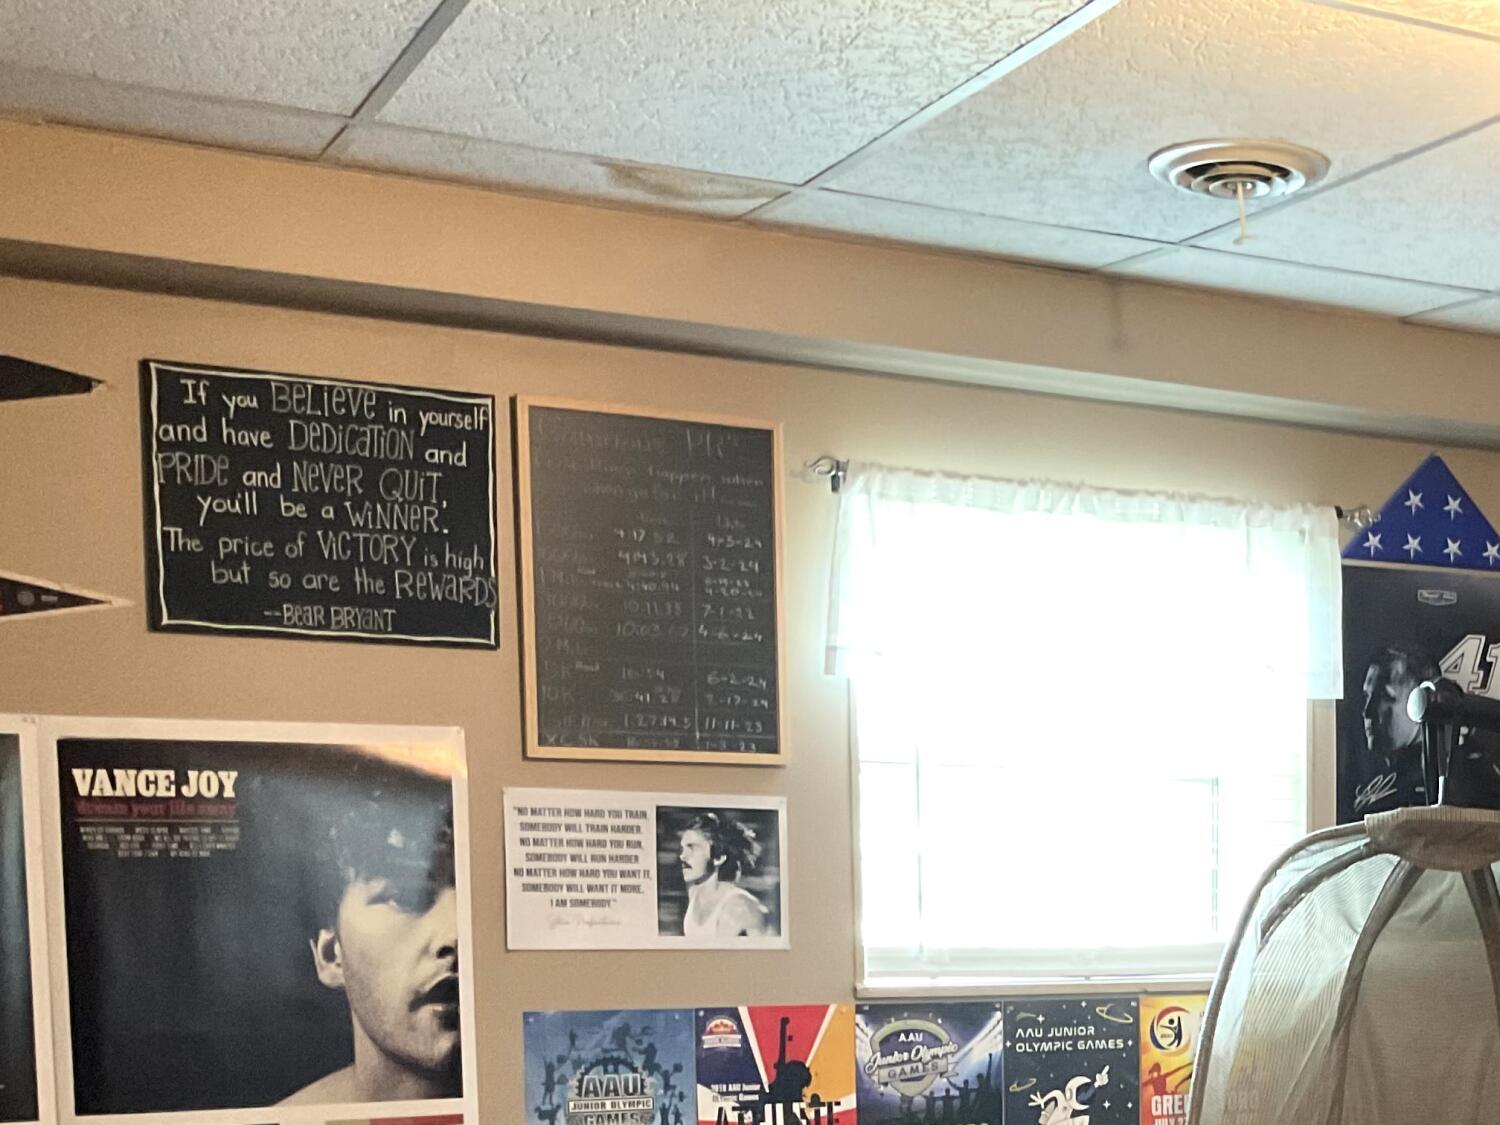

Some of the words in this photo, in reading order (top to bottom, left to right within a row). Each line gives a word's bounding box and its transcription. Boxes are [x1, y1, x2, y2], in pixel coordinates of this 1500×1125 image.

[180, 379, 209, 405] If
[222, 393, 258, 419] you
[389, 401, 406, 424] in
[419, 406, 489, 437] yourself
[159, 417, 207, 443] and
[222, 418, 274, 447] have
[425, 441, 467, 467] and
[243, 463, 281, 489] and
[197, 491, 257, 526] you'll
[281, 499, 307, 518] be
[322, 505, 334, 519] a
[163, 527, 204, 552] The
[219, 536, 274, 559] price
[285, 531, 306, 558] of
[424, 548, 438, 567] is
[445, 543, 484, 580] high
[212, 562, 251, 585] but
[269, 573, 291, 590] so
[302, 577, 340, 591] are
[355, 567, 385, 595] the
[72, 769, 176, 797] VANCE
[181, 771, 238, 798] JOY
[530, 807, 561, 817] MATTER
[564, 808, 582, 817] HOW
[584, 808, 605, 818] HARD
[607, 809, 622, 818] YOU
[520, 822, 562, 832] SOMEBODY
[564, 823, 583, 832] WILL
[585, 823, 608, 833] TRAIN
[520, 837, 529, 846] NO
[530, 838, 563, 848] MATTER
[566, 839, 583, 847] HOW
[585, 839, 607, 848] HARD
[610, 839, 624, 848] YOU
[525, 852, 567, 863] SOMEBODY
[570, 853, 588, 863] WILL
[590, 855, 606, 864] RUN
[514, 868, 524, 877] NO
[526, 868, 557, 878] MATTER
[559, 869, 577, 878] HOW
[579, 869, 601, 878] HARD
[603, 869, 618, 878] YOU
[620, 870, 641, 879] WANT
[522, 883, 564, 893] SOMEBODY
[566, 883, 584, 893] WILL
[587, 884, 608, 893] WANT
[611, 884, 617, 893] IT
[551, 899, 554, 907] I
[555, 898, 567, 907] AM
[898, 1033, 923, 1042] AAU
[1016, 1028, 1043, 1038] AAU
[1048, 1026, 1095, 1037] JUNIOR
[1016, 1039, 1072, 1052] OLYMPIC
[1078, 1039, 1123, 1049] GAMES
[865, 1047, 909, 1073] Junior
[911, 1041, 959, 1062] Olympic
[888, 1061, 940, 1079] GAMES
[582, 1074, 643, 1097] AAU
[570, 1100, 607, 1110] JUNIOR
[611, 1098, 651, 1109] OLYMPIC
[583, 1113, 641, 1125] GAMES
